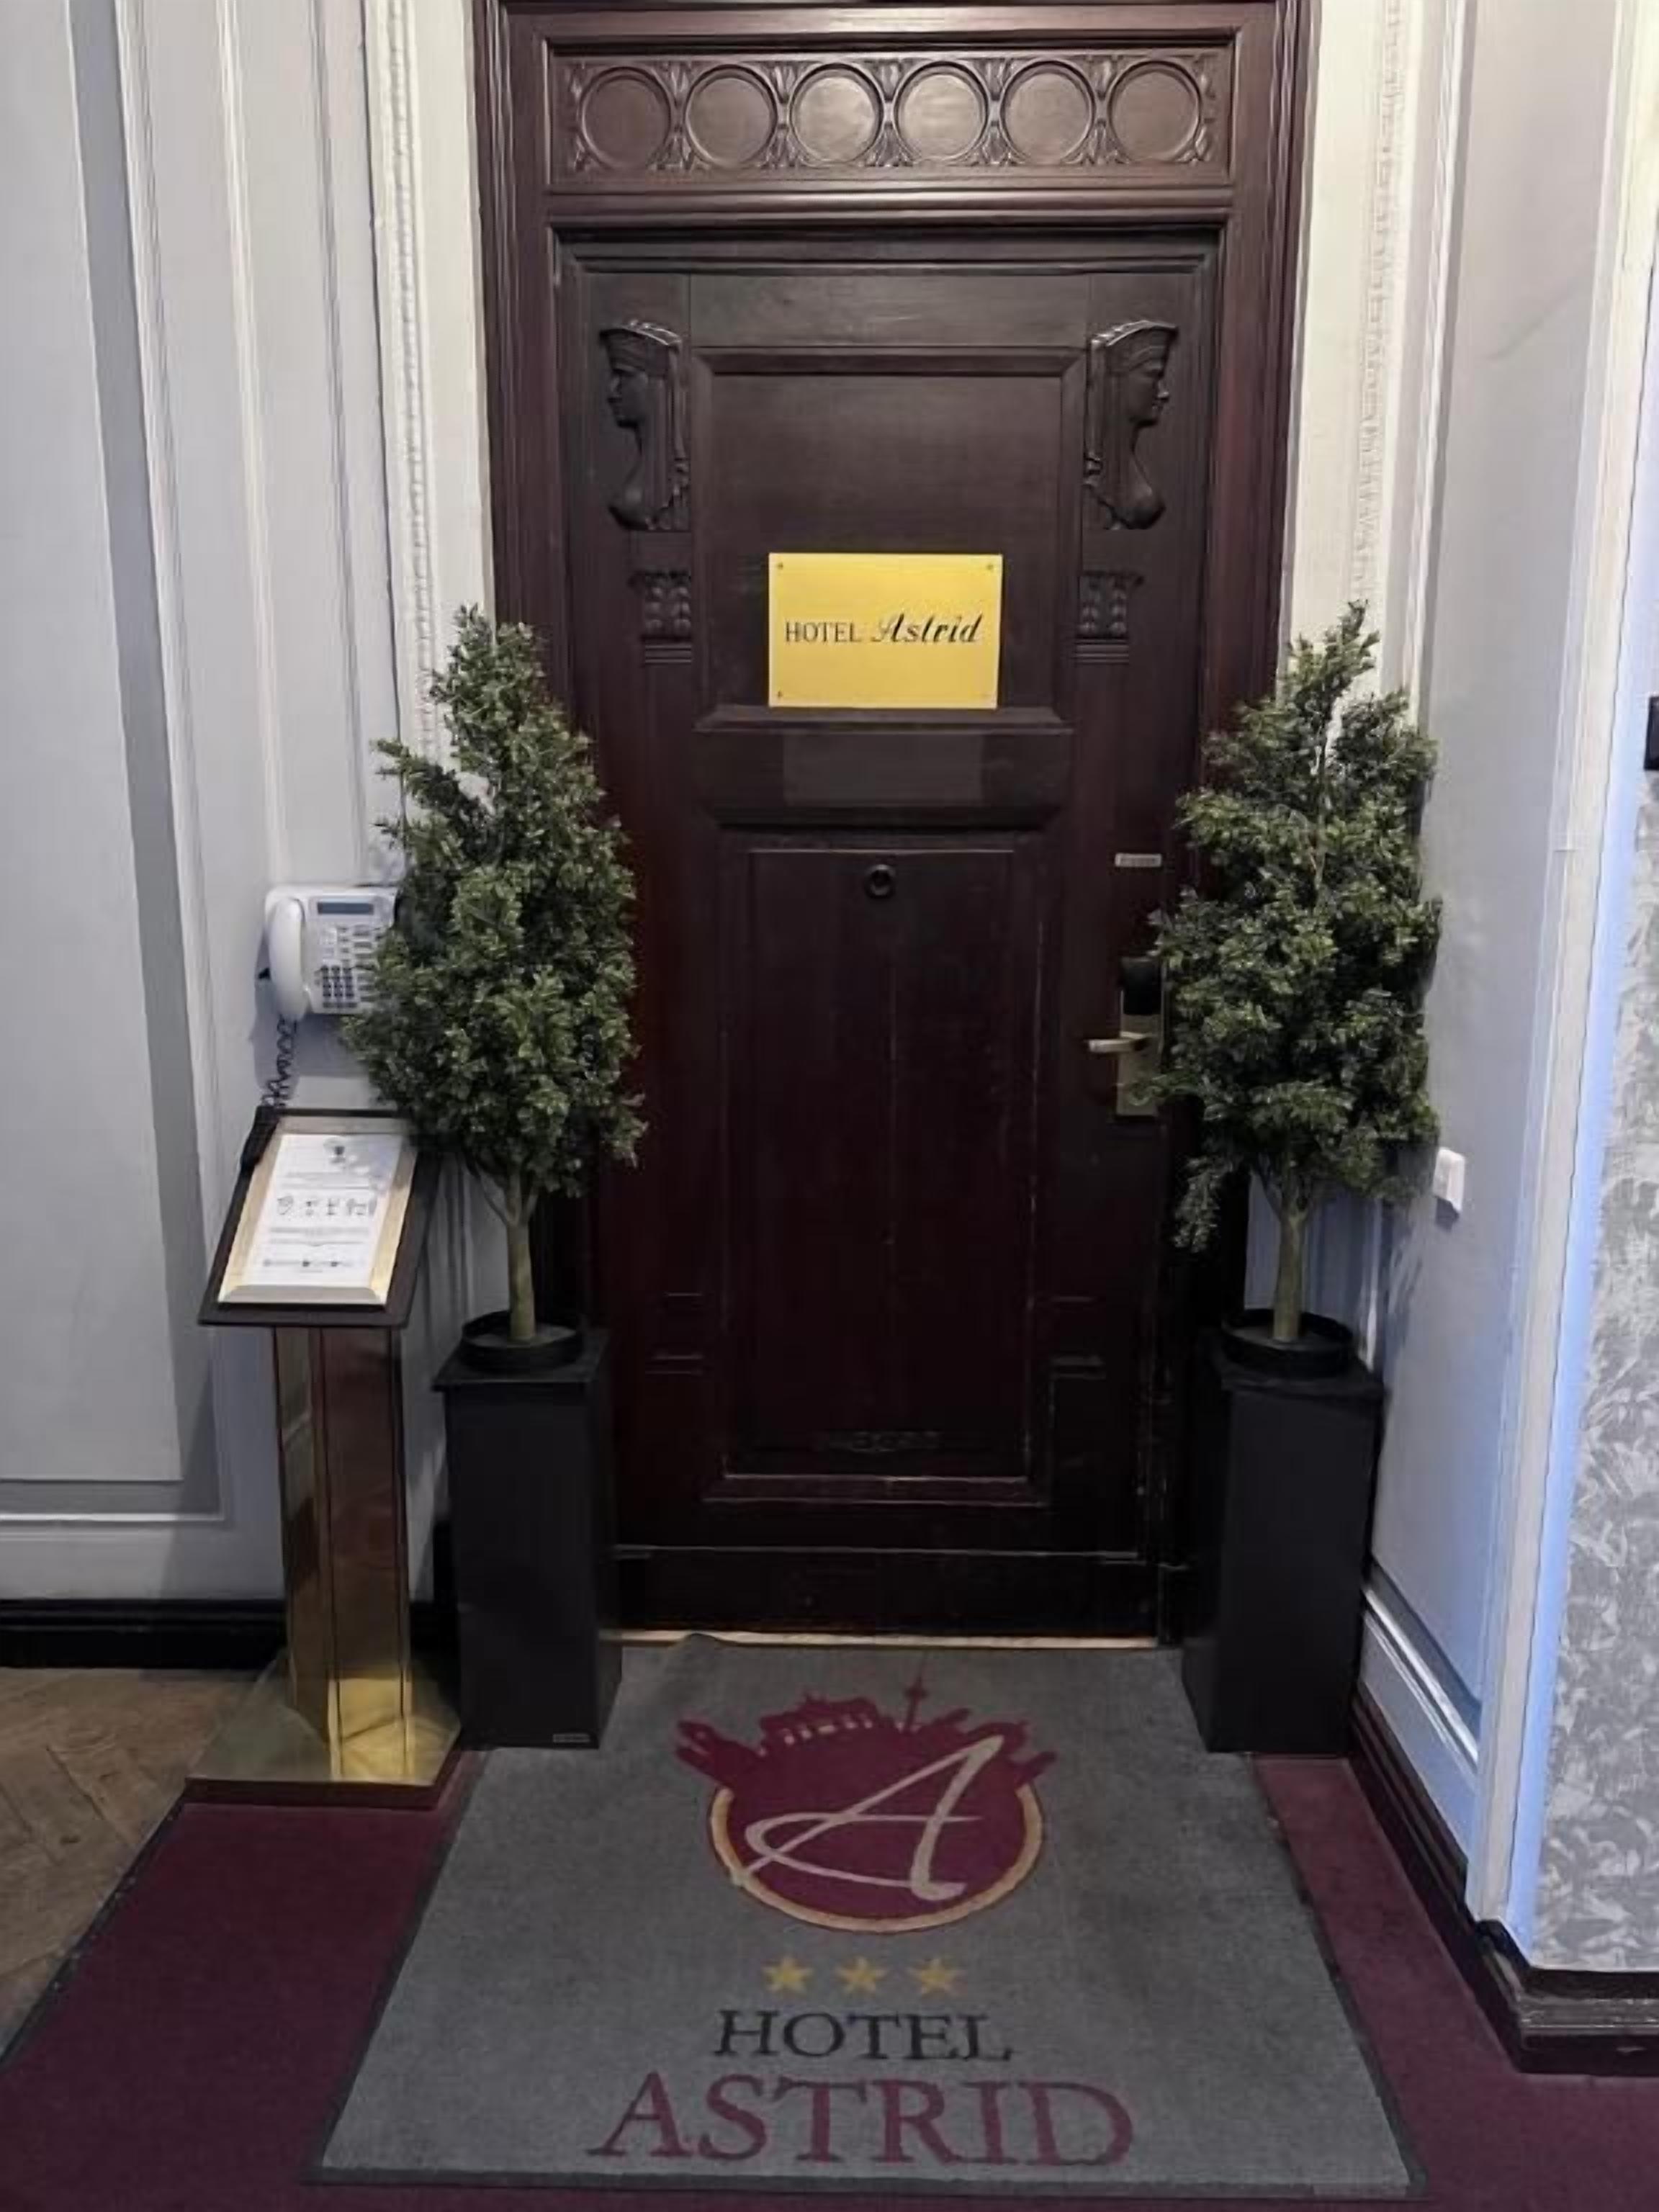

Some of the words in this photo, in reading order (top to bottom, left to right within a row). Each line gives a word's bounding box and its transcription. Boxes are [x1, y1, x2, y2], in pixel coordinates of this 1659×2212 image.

[784, 620, 862, 643] HOTEL
[870, 612, 984, 643] Astrid
[714, 2010, 1012, 2063] HOTEL
[585, 2070, 1134, 2166] ASTRID
